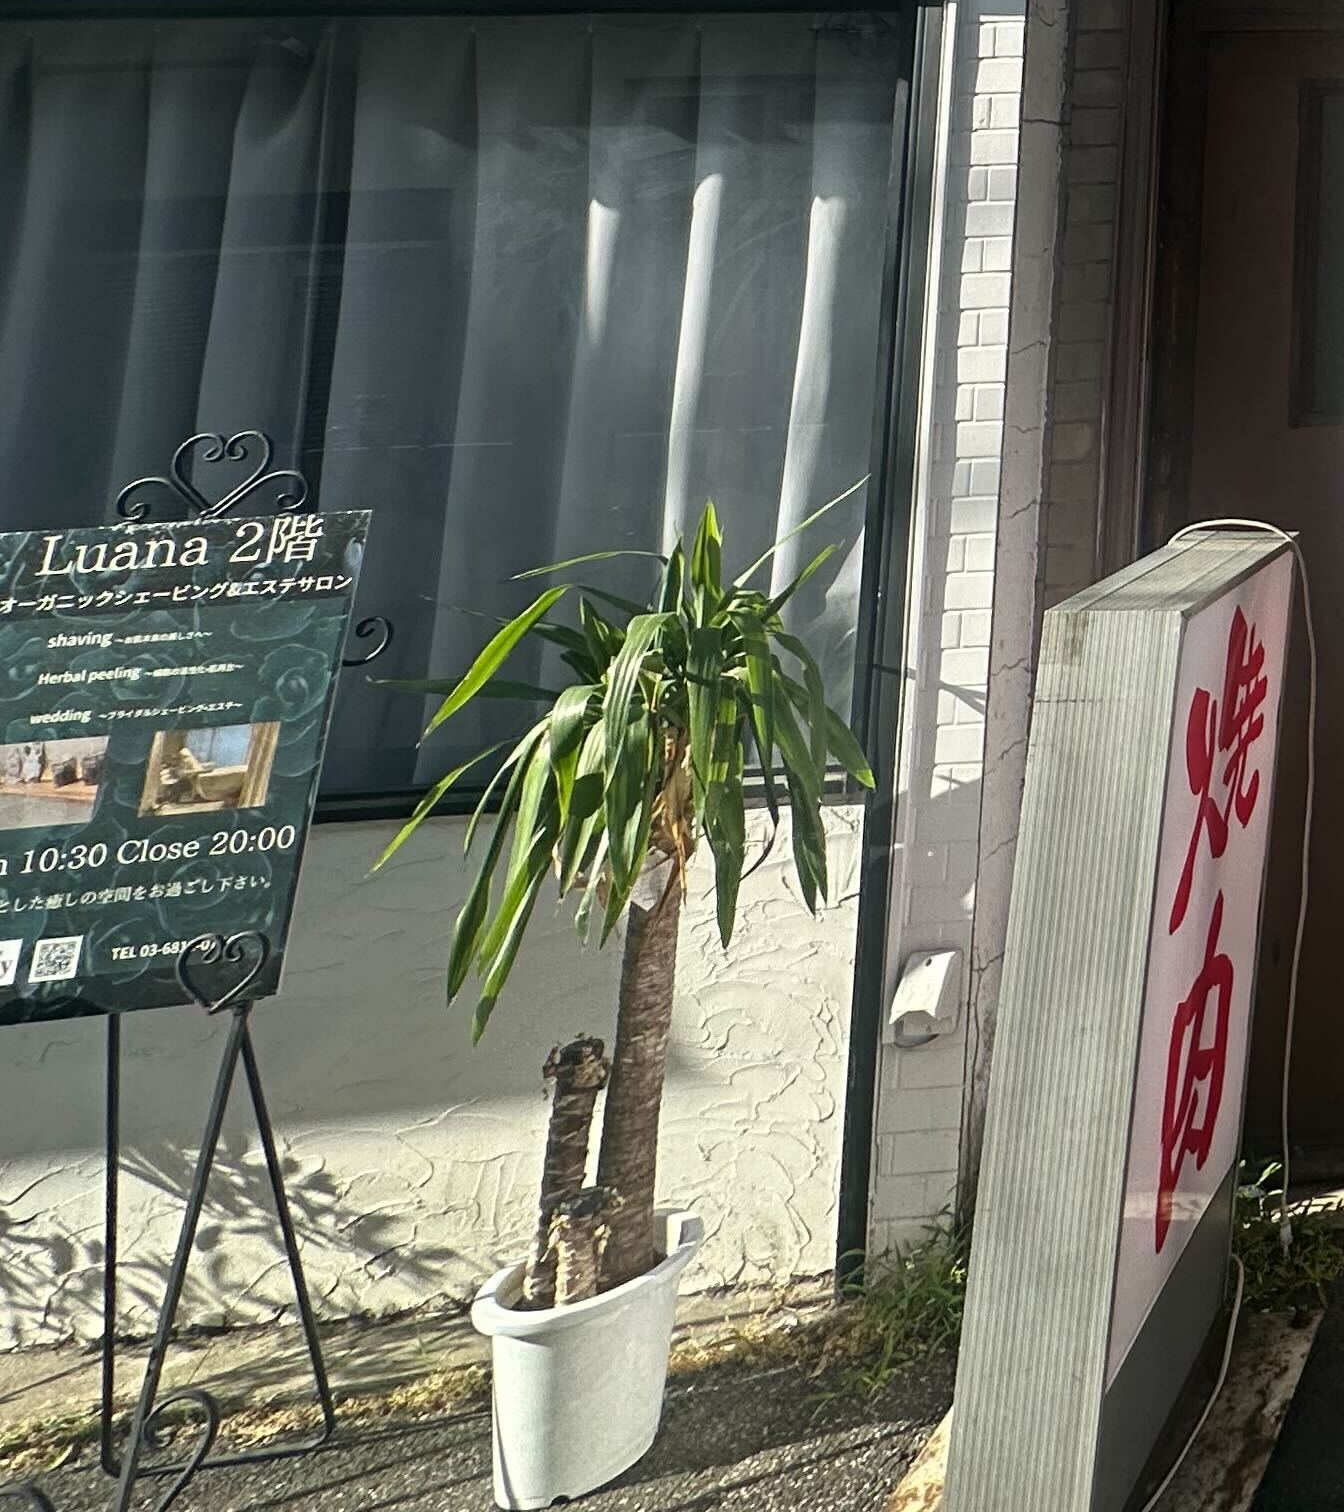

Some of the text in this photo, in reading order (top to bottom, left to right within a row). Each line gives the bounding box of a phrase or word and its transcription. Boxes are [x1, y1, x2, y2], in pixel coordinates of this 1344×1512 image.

[34, 514, 324, 577] Luana 2階
[47, 631, 114, 649] shaving
[37, 669, 87, 685] Herbal
[87, 666, 143, 684] peeling
[29, 709, 93, 725] wedding
[19, 843, 107, 874] 10:30
[117, 839, 201, 865] Close
[208, 824, 296, 856] 20:00
[1155, 603, 1268, 1256] 焼肉
[111, 946, 137, 961] TEL
